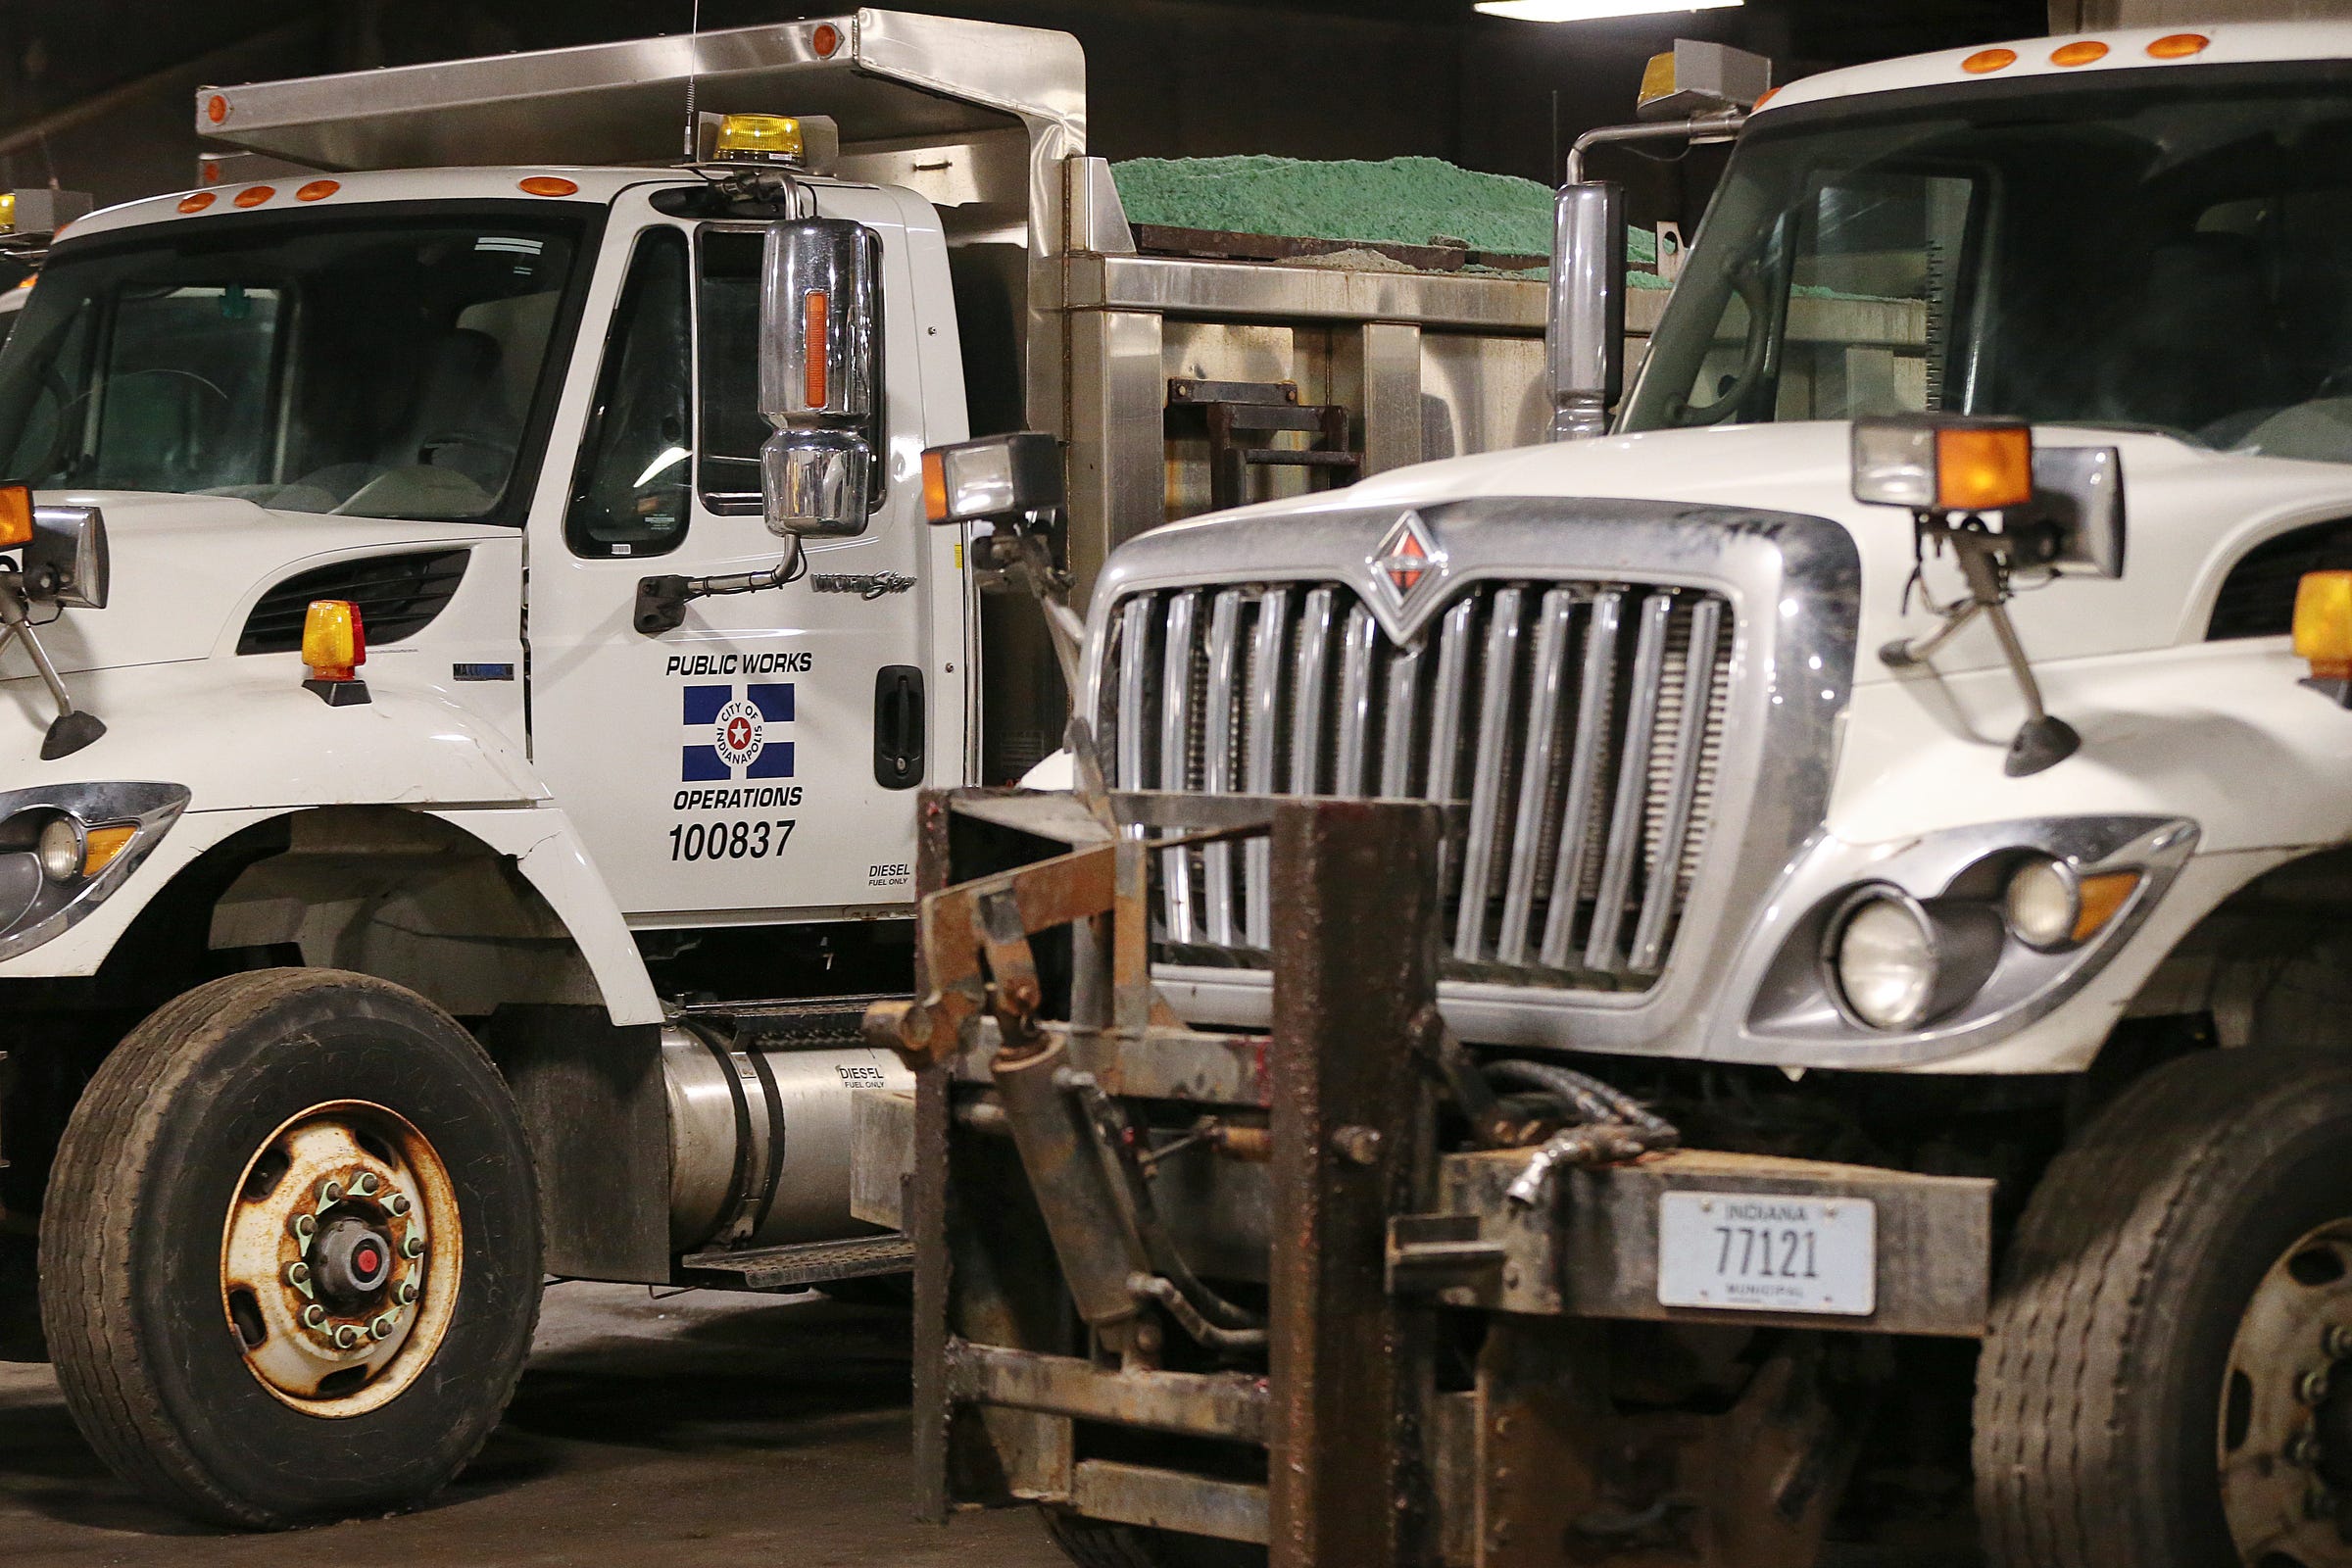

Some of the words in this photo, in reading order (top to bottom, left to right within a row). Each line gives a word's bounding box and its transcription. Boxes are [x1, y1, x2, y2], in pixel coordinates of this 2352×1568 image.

[666, 655, 738, 676] PUBLIC
[743, 653, 812, 673] WORKS
[721, 702, 742, 722] CITY
[745, 705, 759, 720] OF
[716, 725, 762, 765] INDIANAPOLIS
[673, 786, 803, 810] OPERATIONS
[669, 819, 796, 861] 100837
[868, 863, 910, 877] DIESEL
[888, 877, 908, 886] ONLY
[839, 1067, 884, 1079] DIESEL
[1726, 1204, 1807, 1222] INDIANA
[1716, 1226, 1817, 1278] 77121
